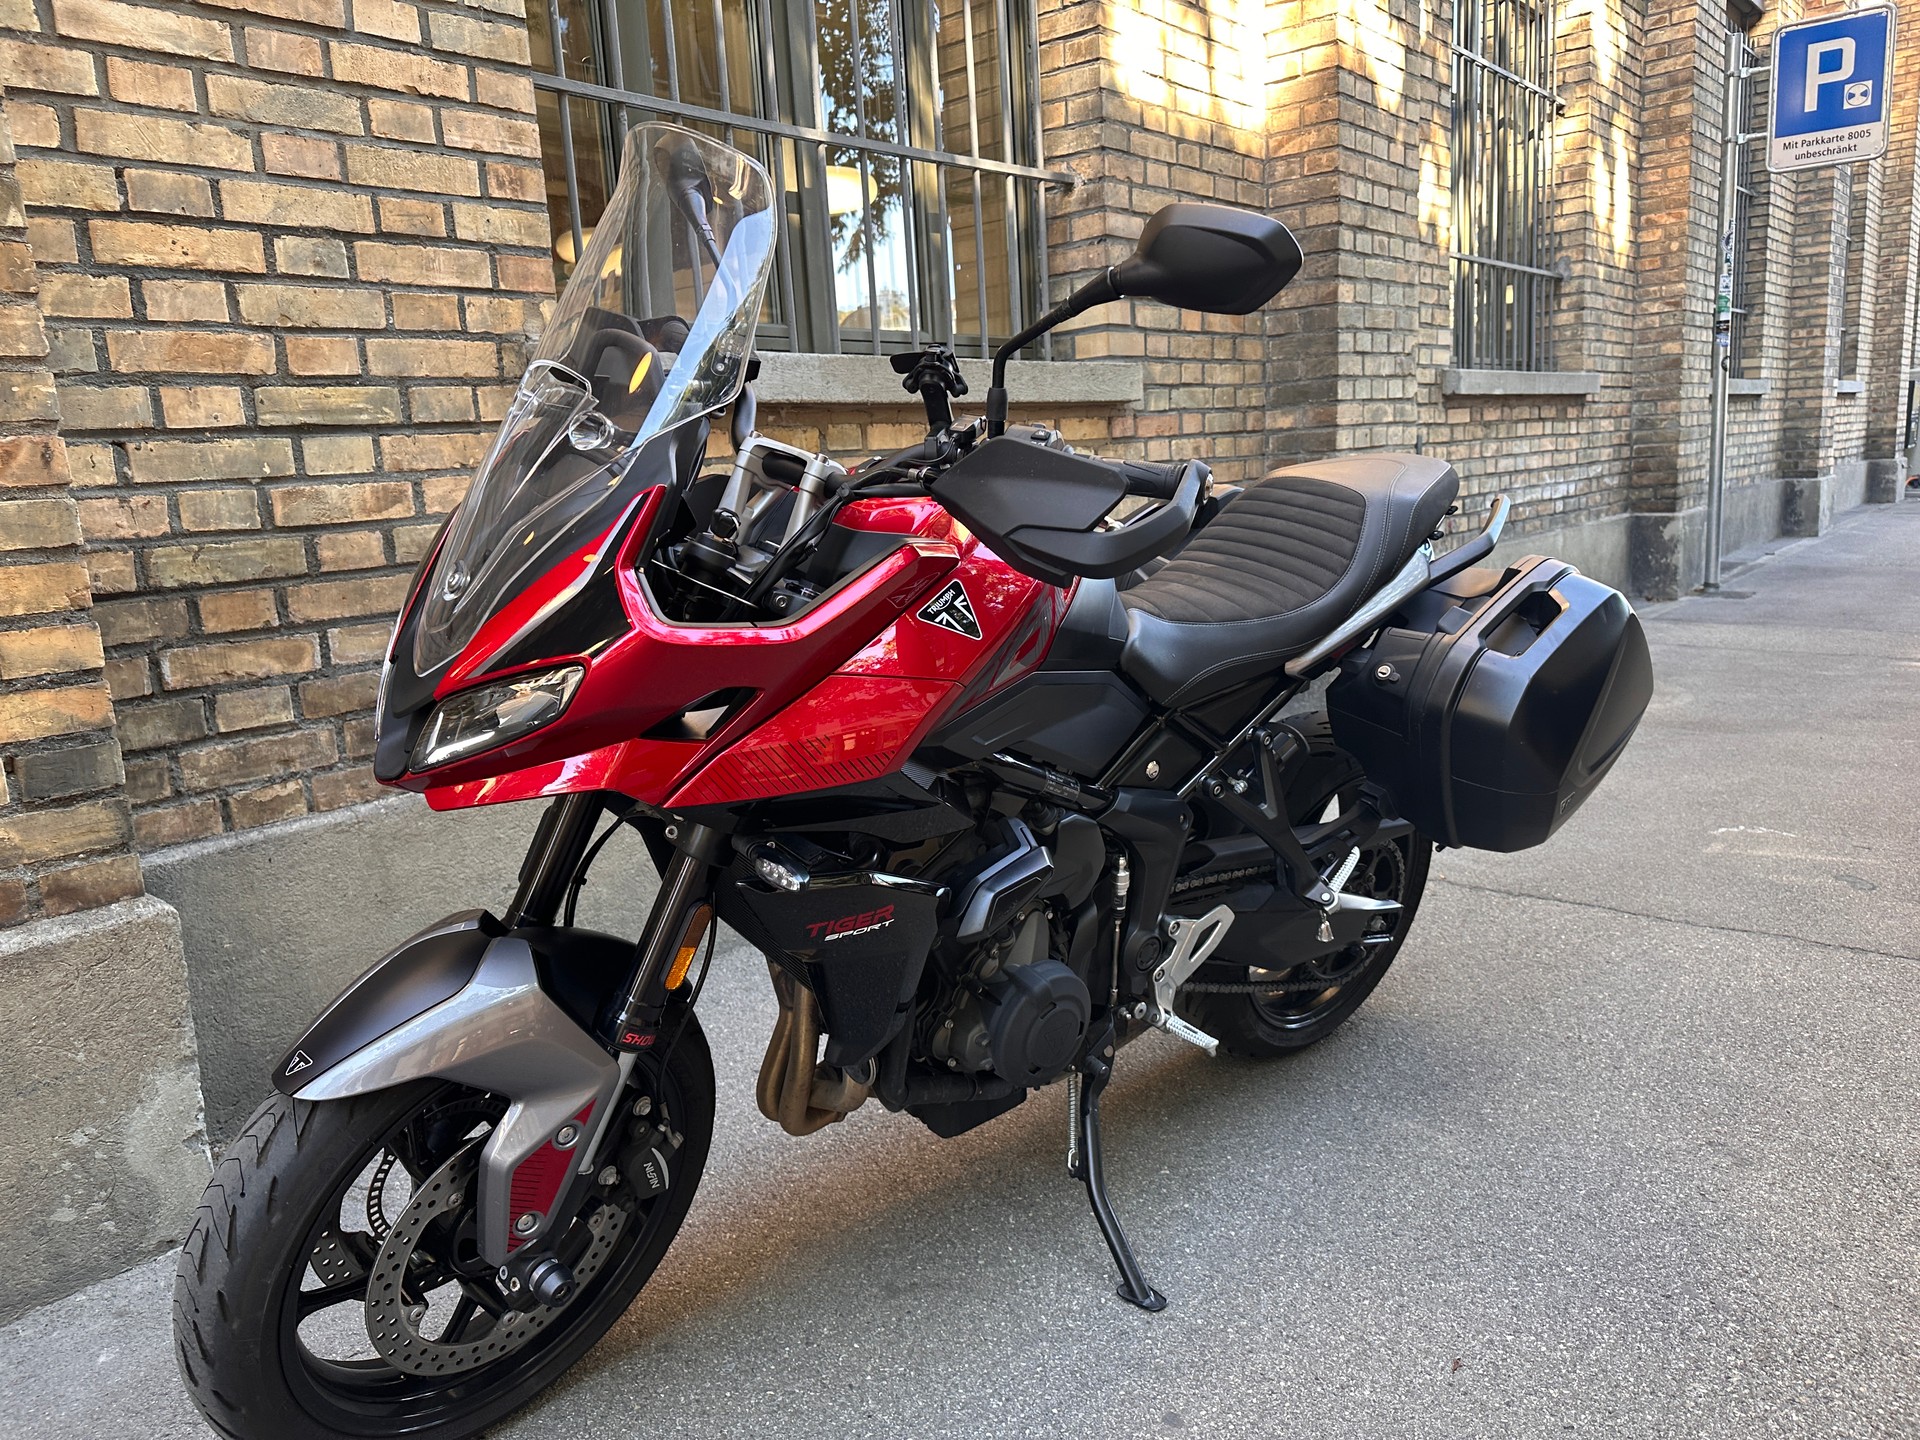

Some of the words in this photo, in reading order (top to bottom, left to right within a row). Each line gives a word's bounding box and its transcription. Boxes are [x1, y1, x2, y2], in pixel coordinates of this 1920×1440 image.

[1804, 37, 1856, 112] P
[1782, 141, 1798, 151] Mit
[1801, 134, 1845, 147] Parkkarte
[1847, 129, 1871, 140] 8005
[1795, 144, 1857, 160] unbeschränkt
[927, 589, 956, 614] TRIUMPH
[806, 903, 895, 938] TIGER
[824, 919, 895, 941] SPORT
